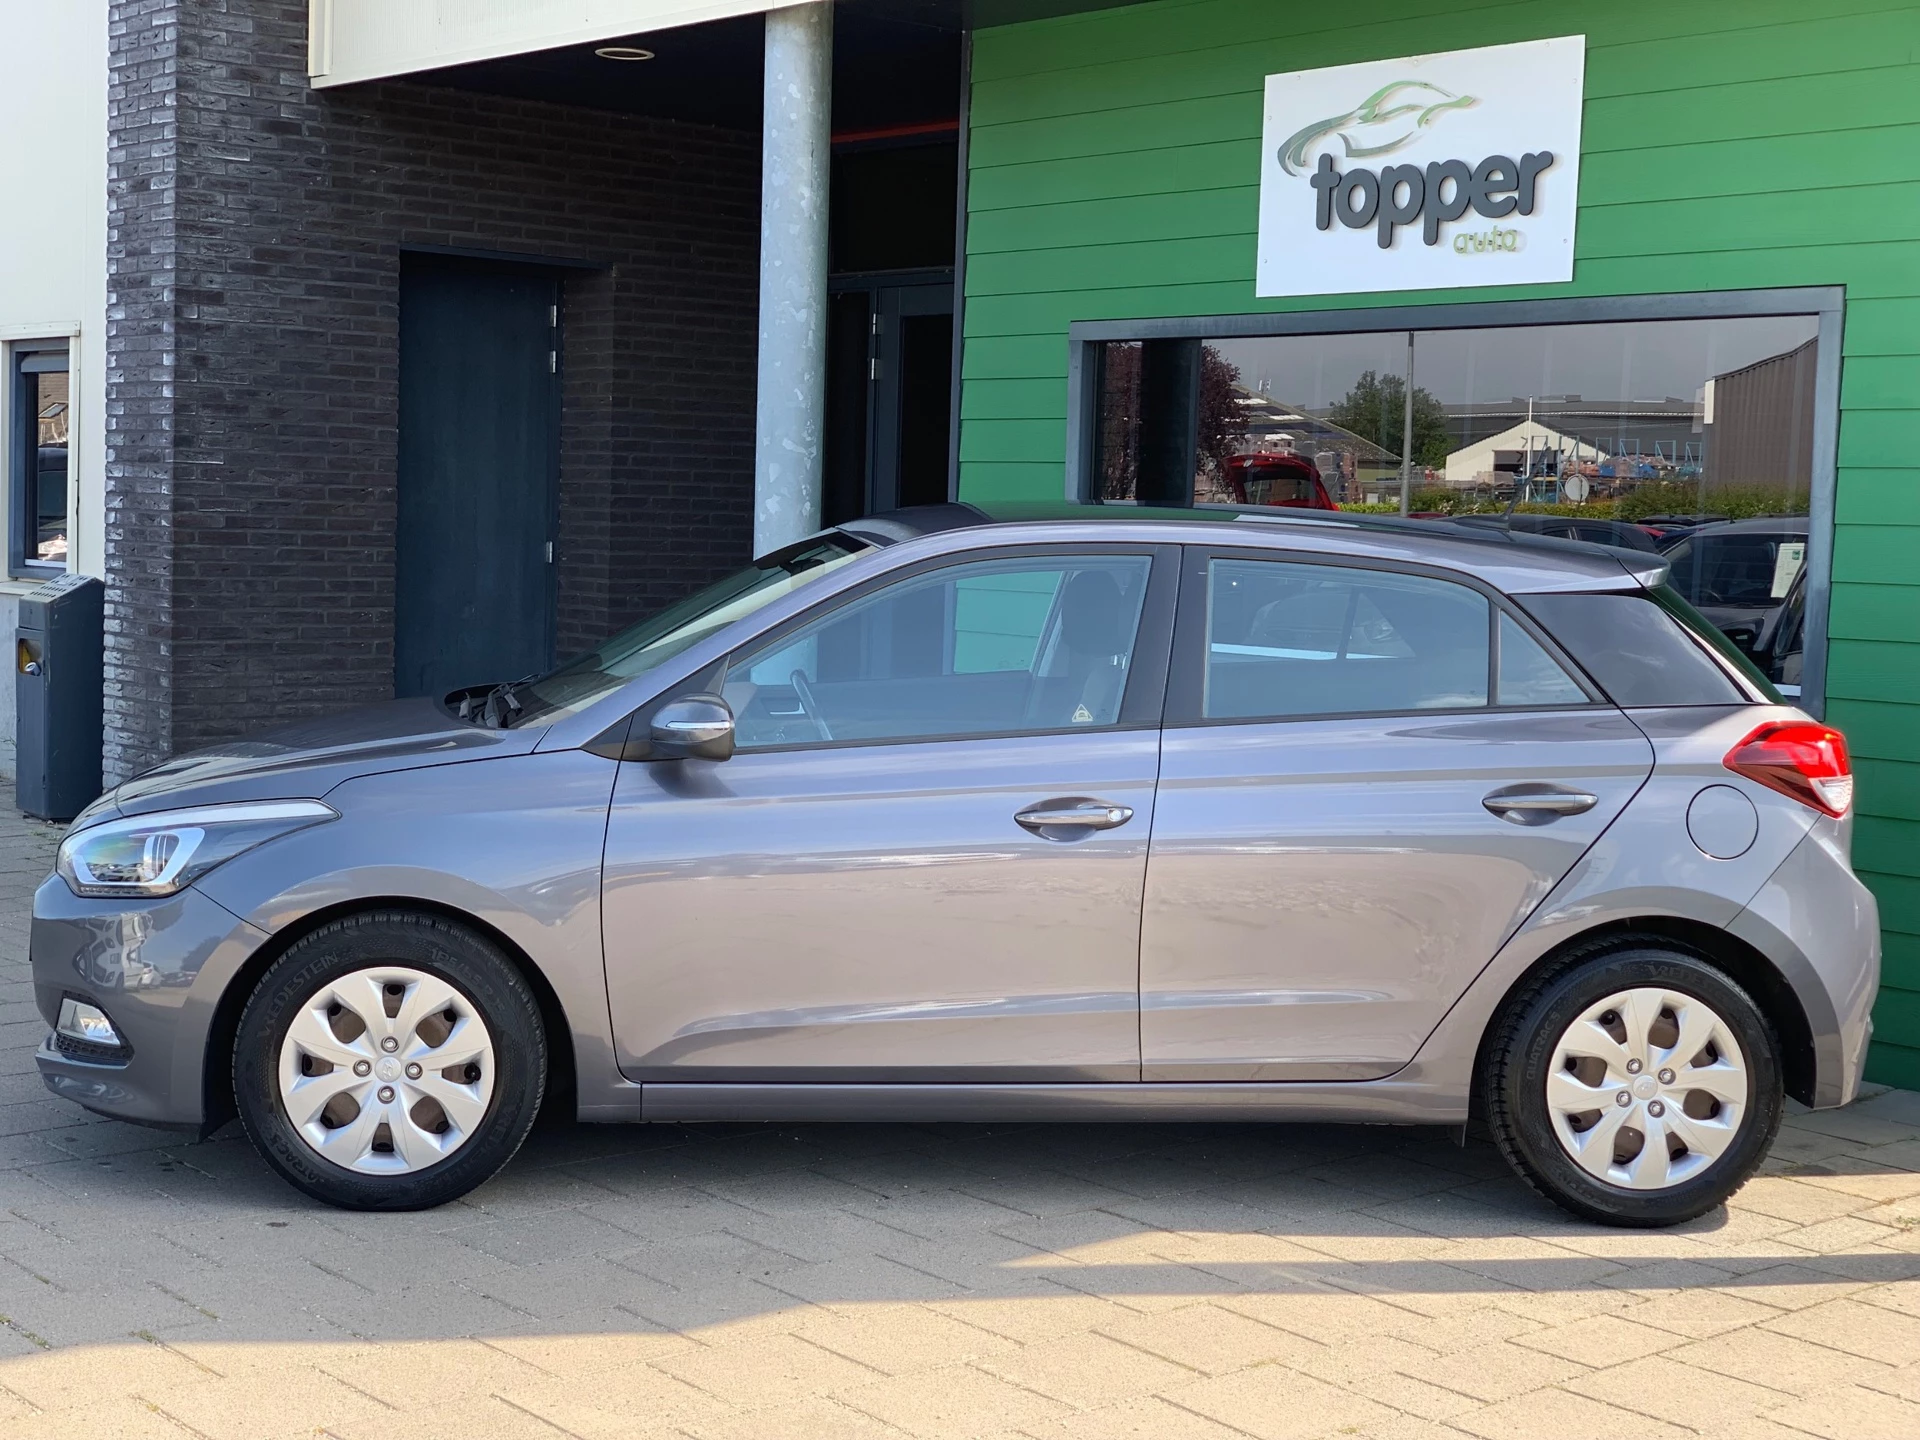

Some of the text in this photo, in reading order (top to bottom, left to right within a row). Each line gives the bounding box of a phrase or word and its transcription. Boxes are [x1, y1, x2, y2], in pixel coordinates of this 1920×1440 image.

[1310, 150, 1554, 249] topper
[1453, 225, 1517, 254] auto
[257, 951, 339, 1038] VREDESTEIN
